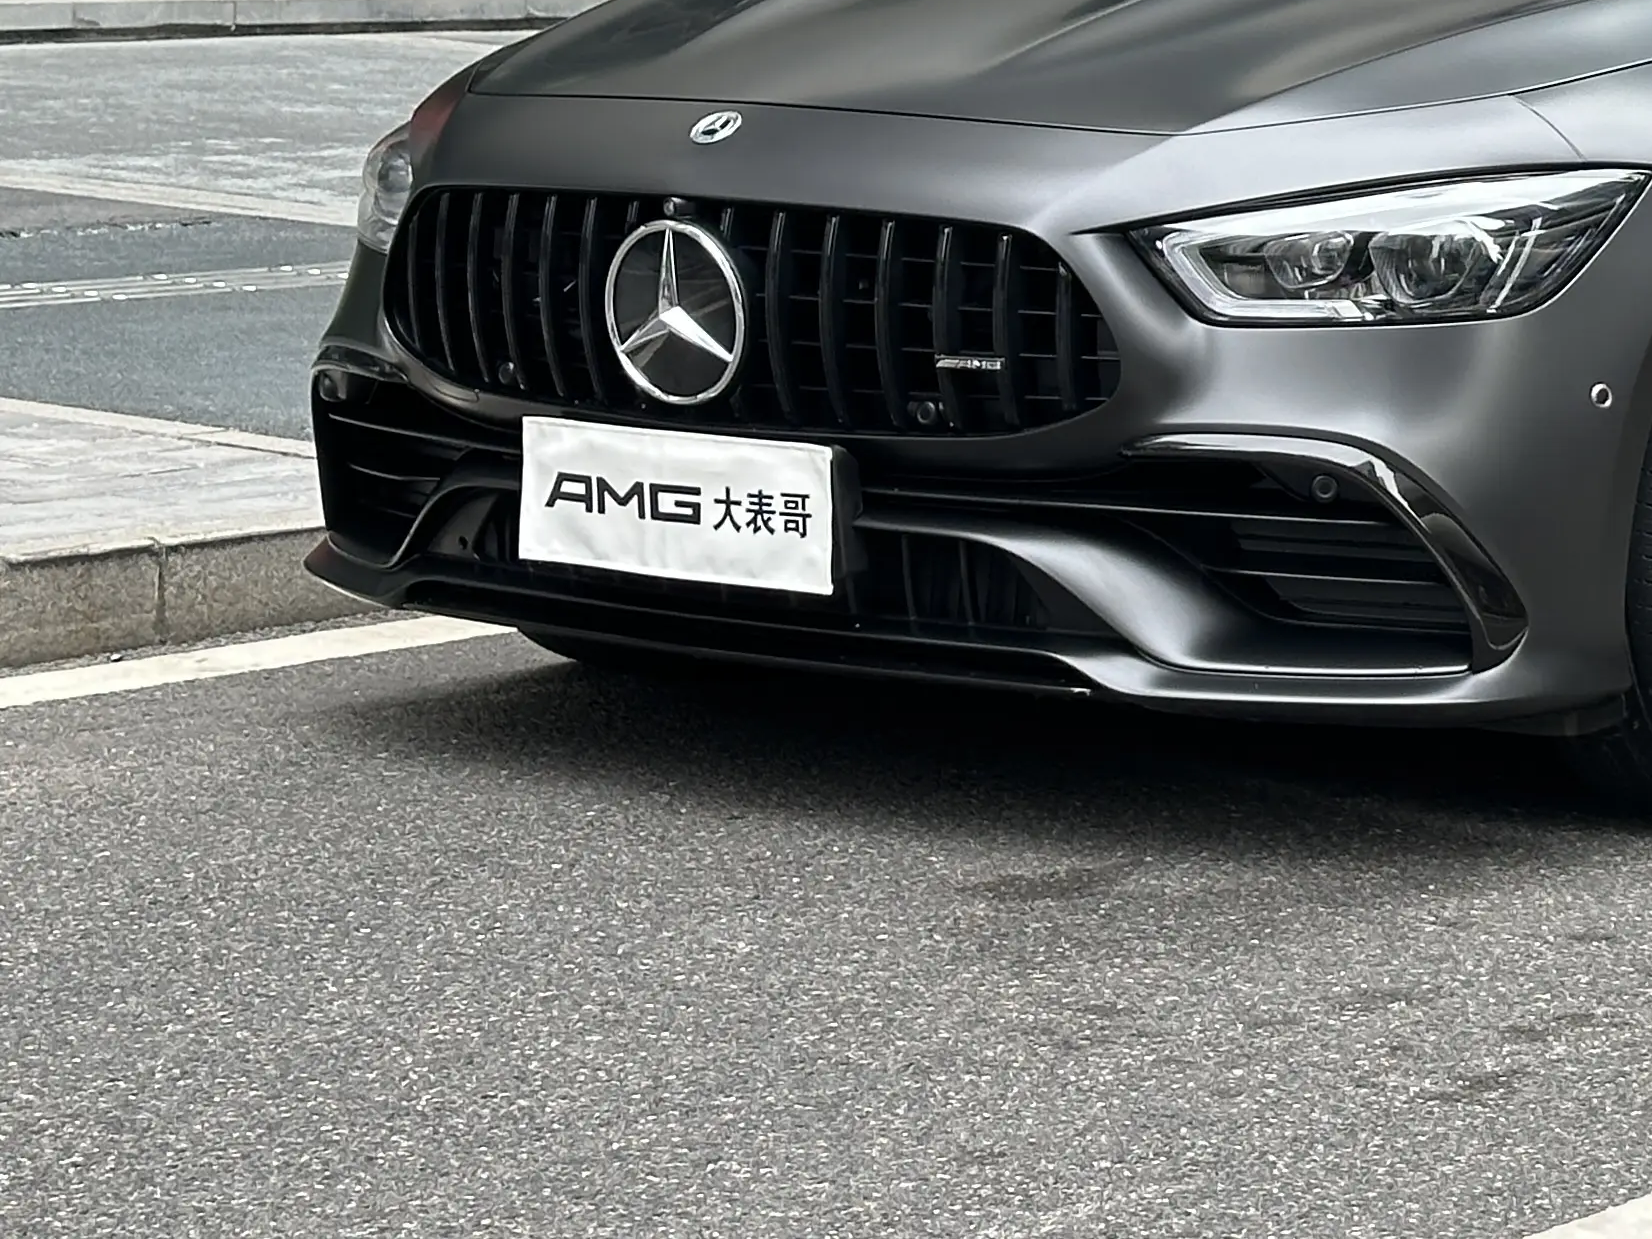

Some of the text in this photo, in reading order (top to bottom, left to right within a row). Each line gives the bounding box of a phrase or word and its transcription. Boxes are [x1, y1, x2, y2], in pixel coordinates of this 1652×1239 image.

[544, 472, 812, 539] AMG 大表哥
